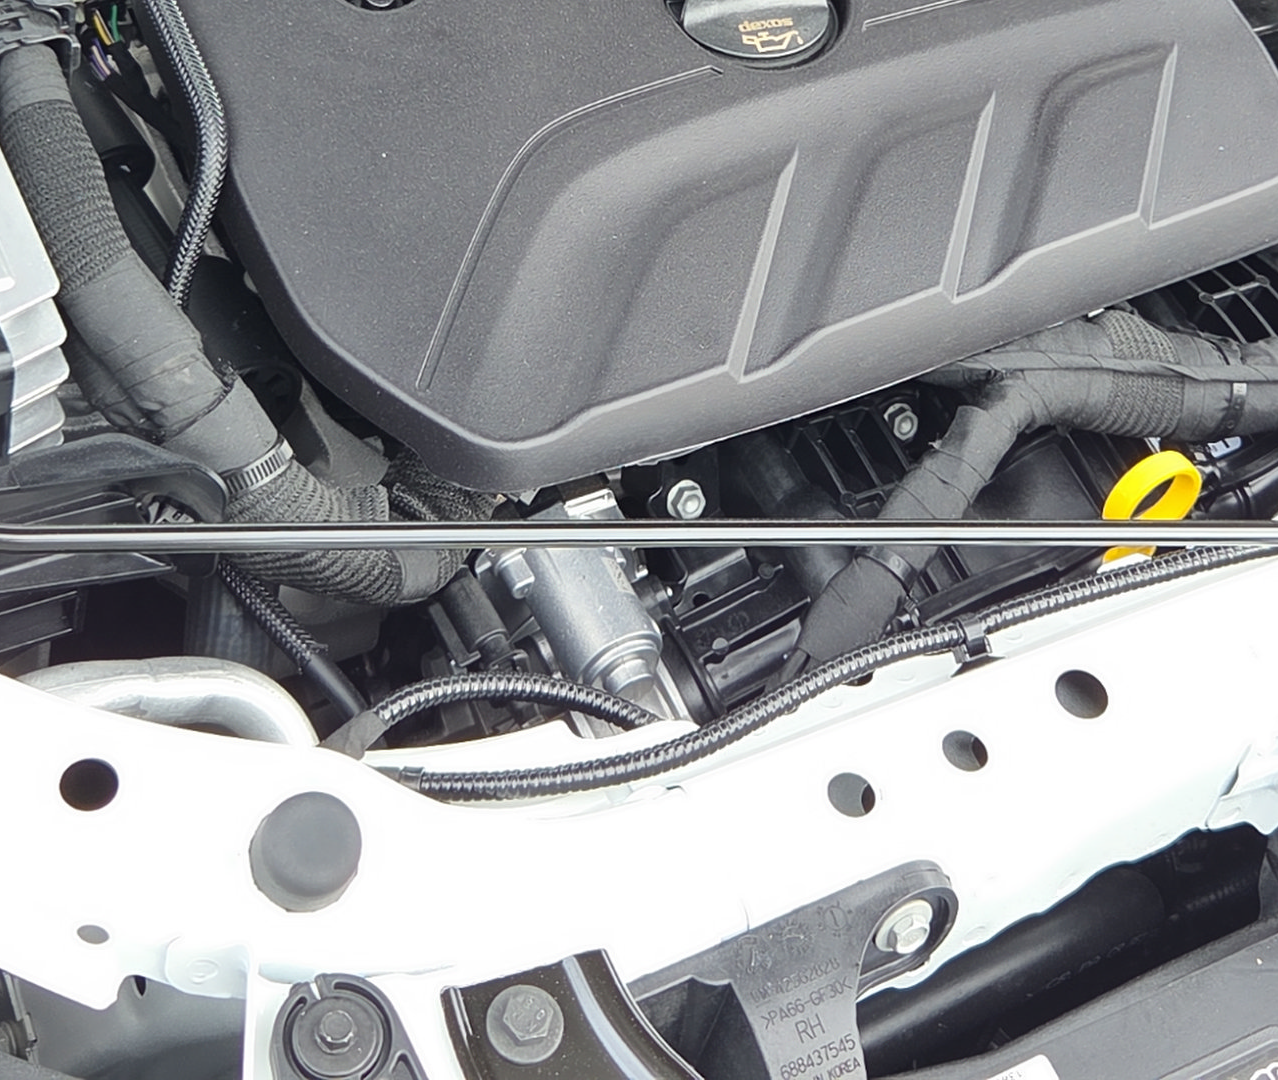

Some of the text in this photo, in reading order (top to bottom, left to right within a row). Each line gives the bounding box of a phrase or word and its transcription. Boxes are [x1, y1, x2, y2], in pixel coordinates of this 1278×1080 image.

[738, 17, 793, 32] dexos
[795, 1013, 825, 1043] RH
[780, 1033, 856, 1080] 688437545
